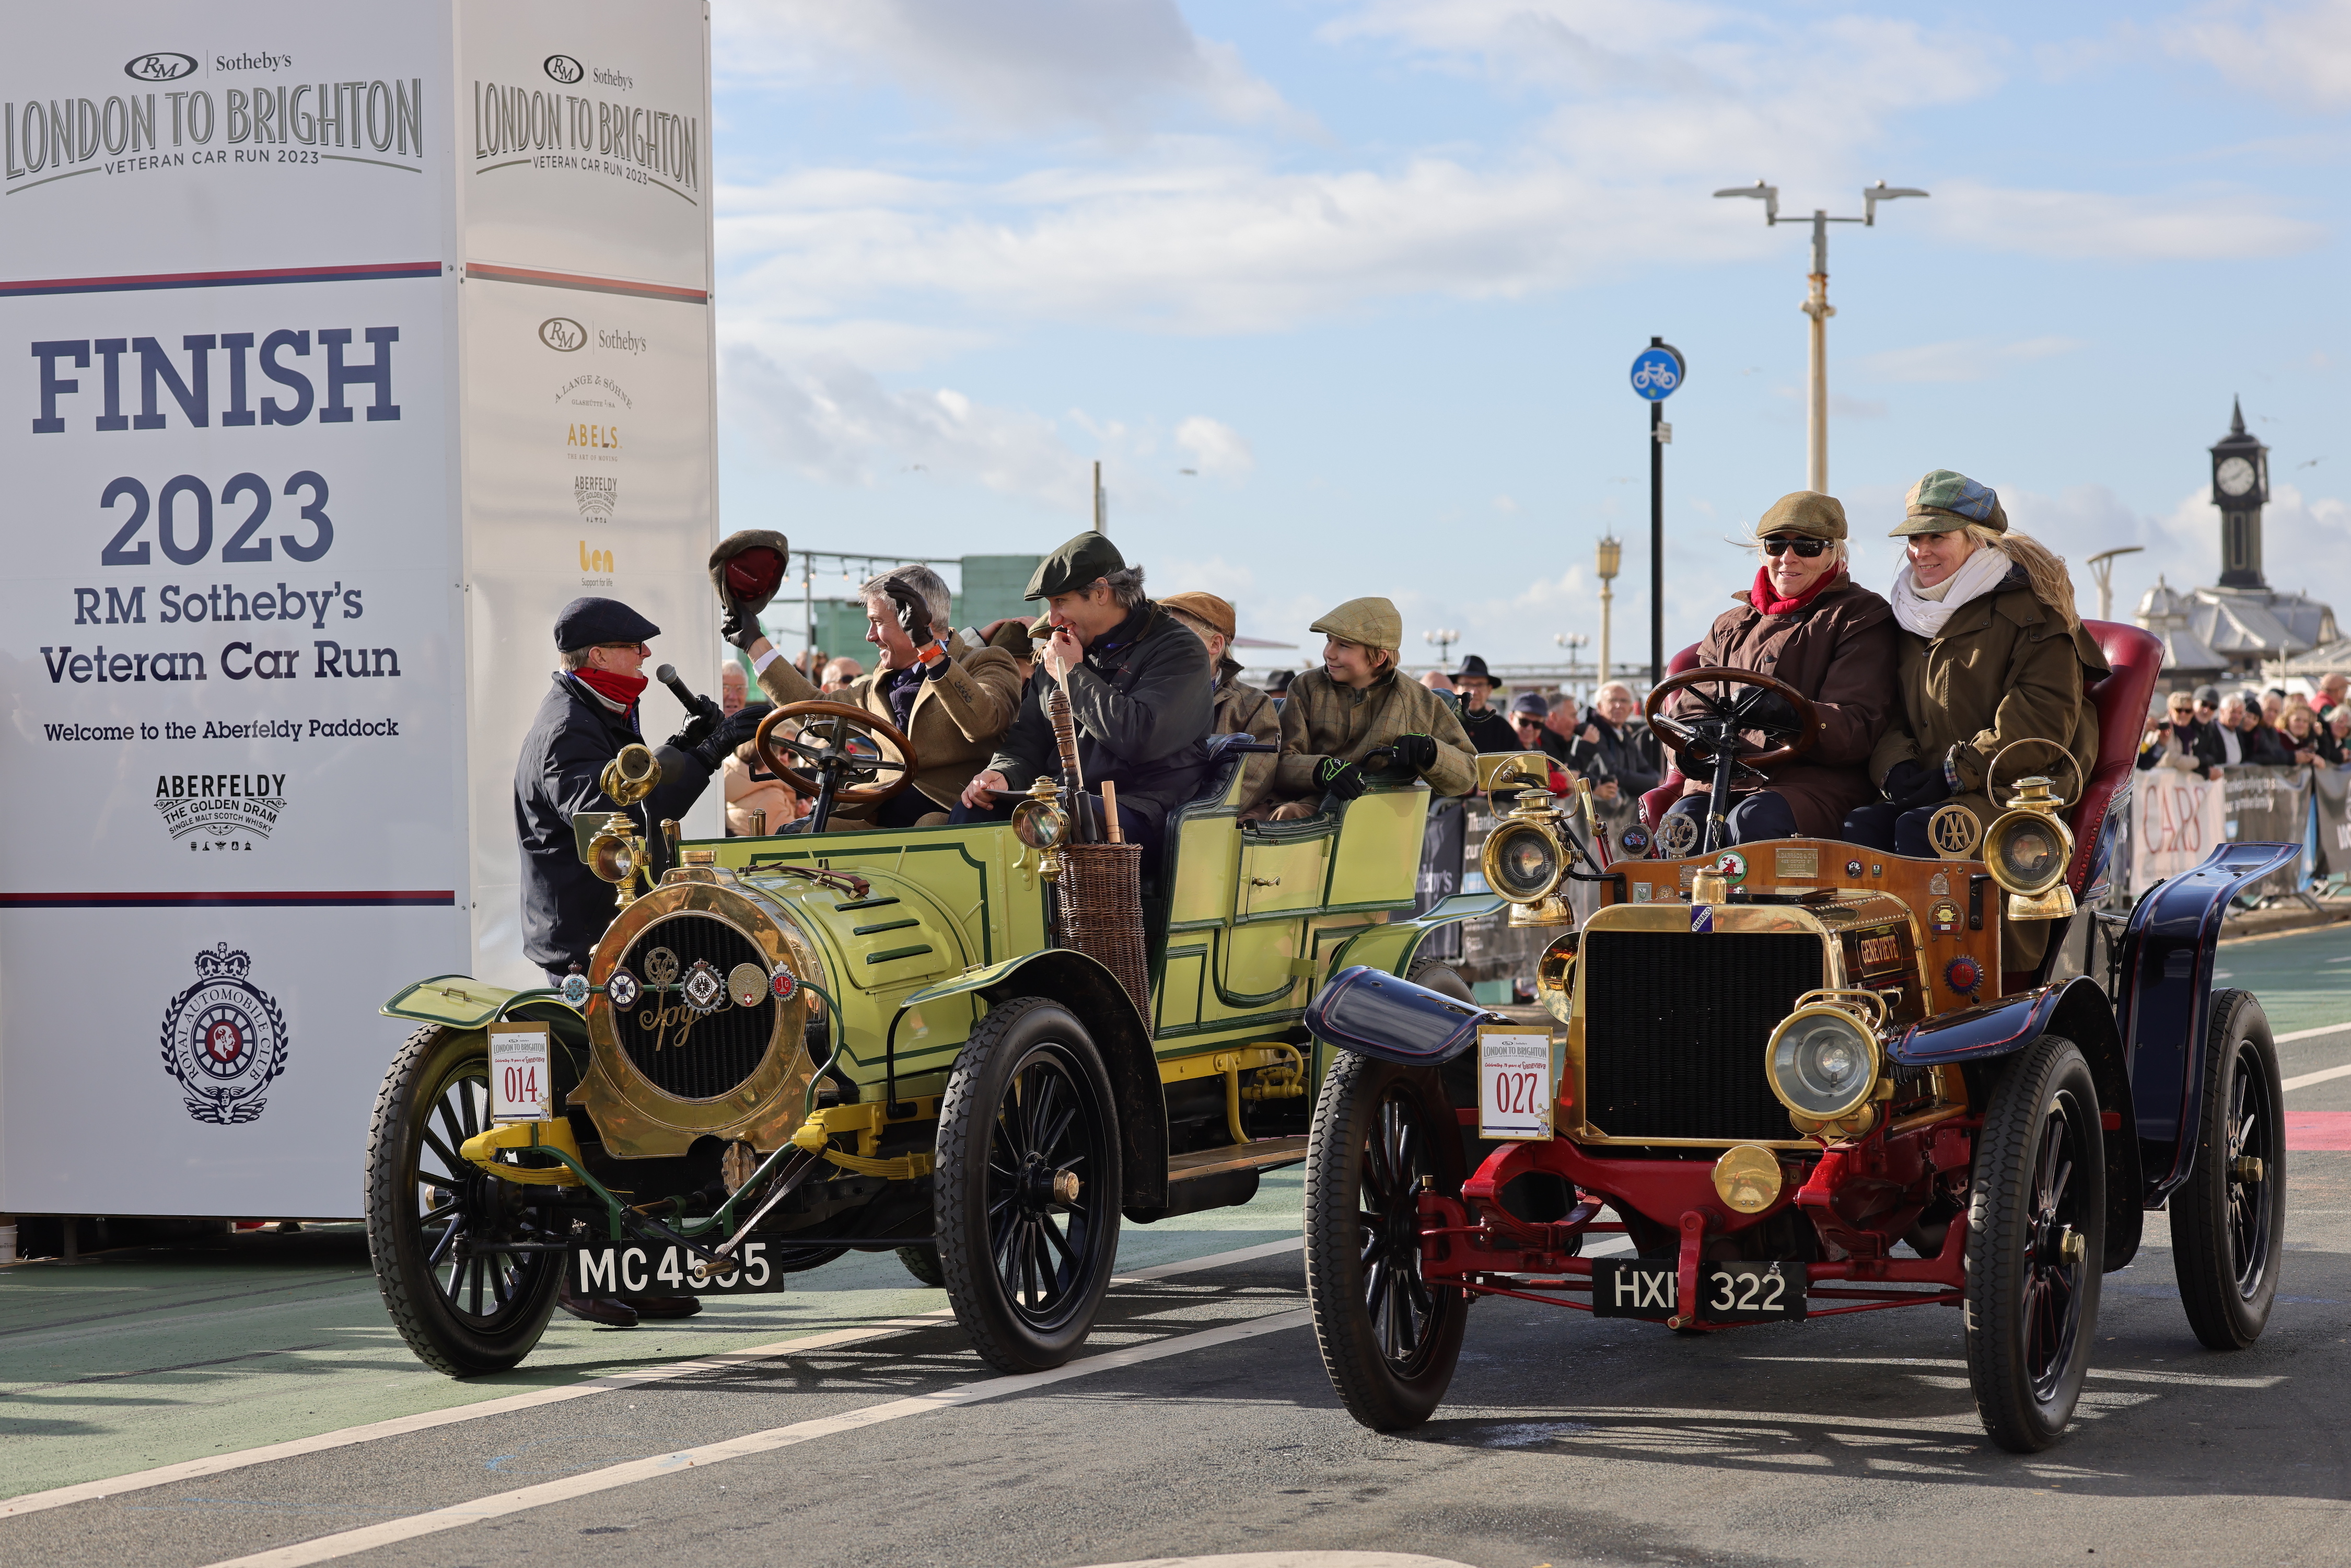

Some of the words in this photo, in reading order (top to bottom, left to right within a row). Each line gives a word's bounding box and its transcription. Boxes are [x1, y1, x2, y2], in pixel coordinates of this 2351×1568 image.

[141, 57, 180, 78] RM
[216, 52, 292, 73] Sotheby's
[553, 58, 574, 81] RM
[593, 67, 633, 91] Sotheby's
[4, 94, 155, 180] LONDON
[165, 90, 214, 146] TO
[227, 78, 422, 157] BRIGHTON
[475, 80, 561, 159] LONDON
[566, 95, 593, 151] TO
[599, 101, 697, 192] BRIGHTON
[104, 153, 184, 176] VETERAN
[192, 150, 227, 165] CAR
[235, 149, 270, 162] RUN
[277, 150, 319, 165] 2023
[533, 156, 577, 169] VETERAN
[581, 157, 600, 172] CAR
[604, 161, 623, 177] RUN
[626, 168, 647, 185] 2023
[550, 322, 575, 348] RM
[599, 329, 646, 356] Sotheby's
[31, 326, 400, 434] FINISH
[562, 375, 592, 395] LANGE
[595, 375, 601, 385] &
[603, 378, 632, 409] SÖHNE
[567, 423, 618, 449] ABELS
[575, 476, 617, 491] ABERFELDY
[577, 496, 585, 506] THE
[586, 491, 602, 500] GOLDEN
[603, 495, 615, 507] DRAM
[100, 470, 334, 566] 2023
[579, 540, 614, 573] ben
[581, 578, 599, 588] Support
[74, 586, 146, 624] RM
[160, 581, 363, 629] Sotheby's
[40, 646, 206, 683] Veteran
[220, 642, 299, 681] Car
[314, 640, 401, 678] Run
[44, 722, 134, 741] Welcome
[141, 722, 159, 740] to
[165, 722, 196, 739] the
[203, 719, 302, 742] Aberfeldy
[308, 718, 399, 737] Paddock
[156, 774, 286, 797] ABERFELDY
[163, 806, 188, 824] THE
[190, 799, 239, 813] GOLDEN
[243, 803, 277, 824] DRAM
[169, 818, 194, 834] SINGLE
[195, 813, 212, 823] MALT
[214, 812, 243, 821] SCOTCH
[245, 816, 273, 833] WHISKY
[1861, 935, 1899, 964] GENEVIEVE
[183, 988, 269, 1032] AUTOMOBILE
[572, 996, 587, 1006] BELGIE
[177, 1027, 200, 1081] ROYAL
[250, 1038, 271, 1081] CLUB
[494, 1043, 514, 1054] LONDON
[521, 1043, 545, 1053] BRIGHTON
[1484, 1047, 1507, 1057] LONDON
[1517, 1047, 1547, 1058] BRIGHTON
[1522, 1061, 1546, 1070] Genevieve
[505, 1066, 538, 1102] 014
[1496, 1073, 1538, 1113] 027
[579, 1247, 648, 1293] MC
[1710, 1272, 1786, 1311] 322
